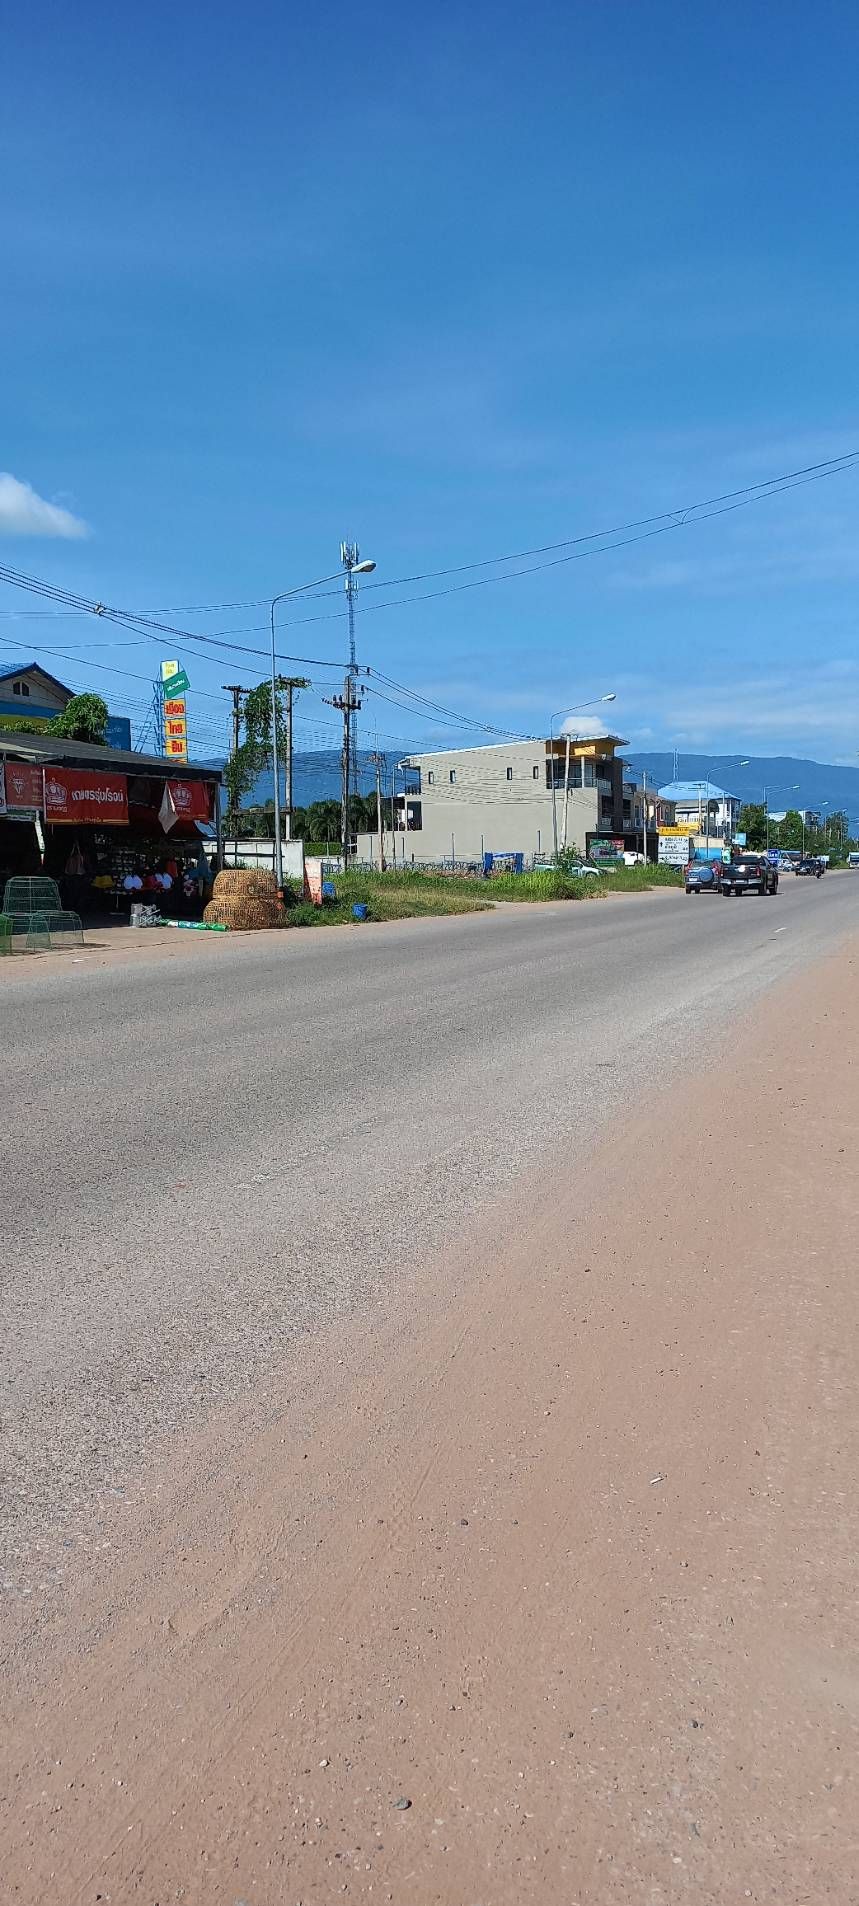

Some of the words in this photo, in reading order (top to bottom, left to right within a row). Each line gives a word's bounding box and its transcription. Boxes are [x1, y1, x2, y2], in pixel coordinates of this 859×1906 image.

[71, 787, 124, 804] เกษตรรุ่งโรจน์
